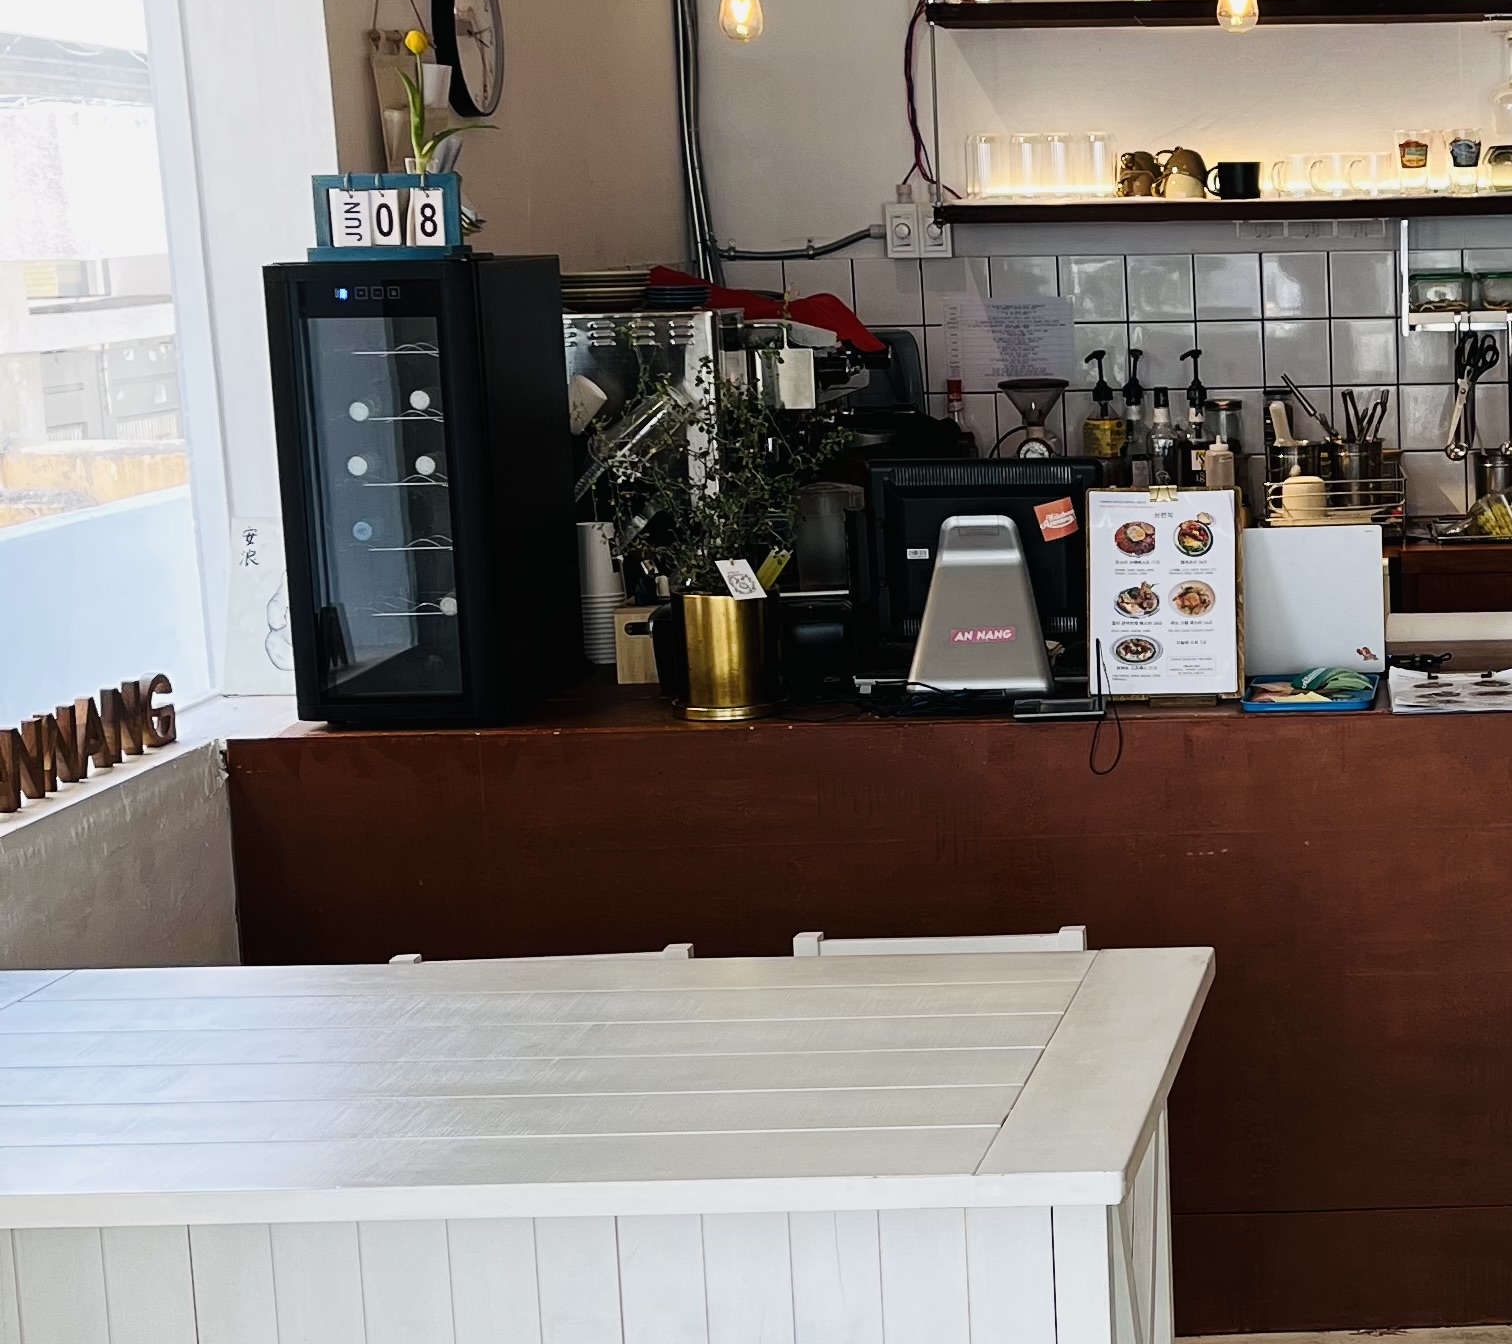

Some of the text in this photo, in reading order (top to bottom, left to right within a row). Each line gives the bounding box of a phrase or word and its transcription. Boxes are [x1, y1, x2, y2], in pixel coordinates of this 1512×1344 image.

[343, 202, 363, 242] JUN
[954, 630, 1012, 642] AN NANG
